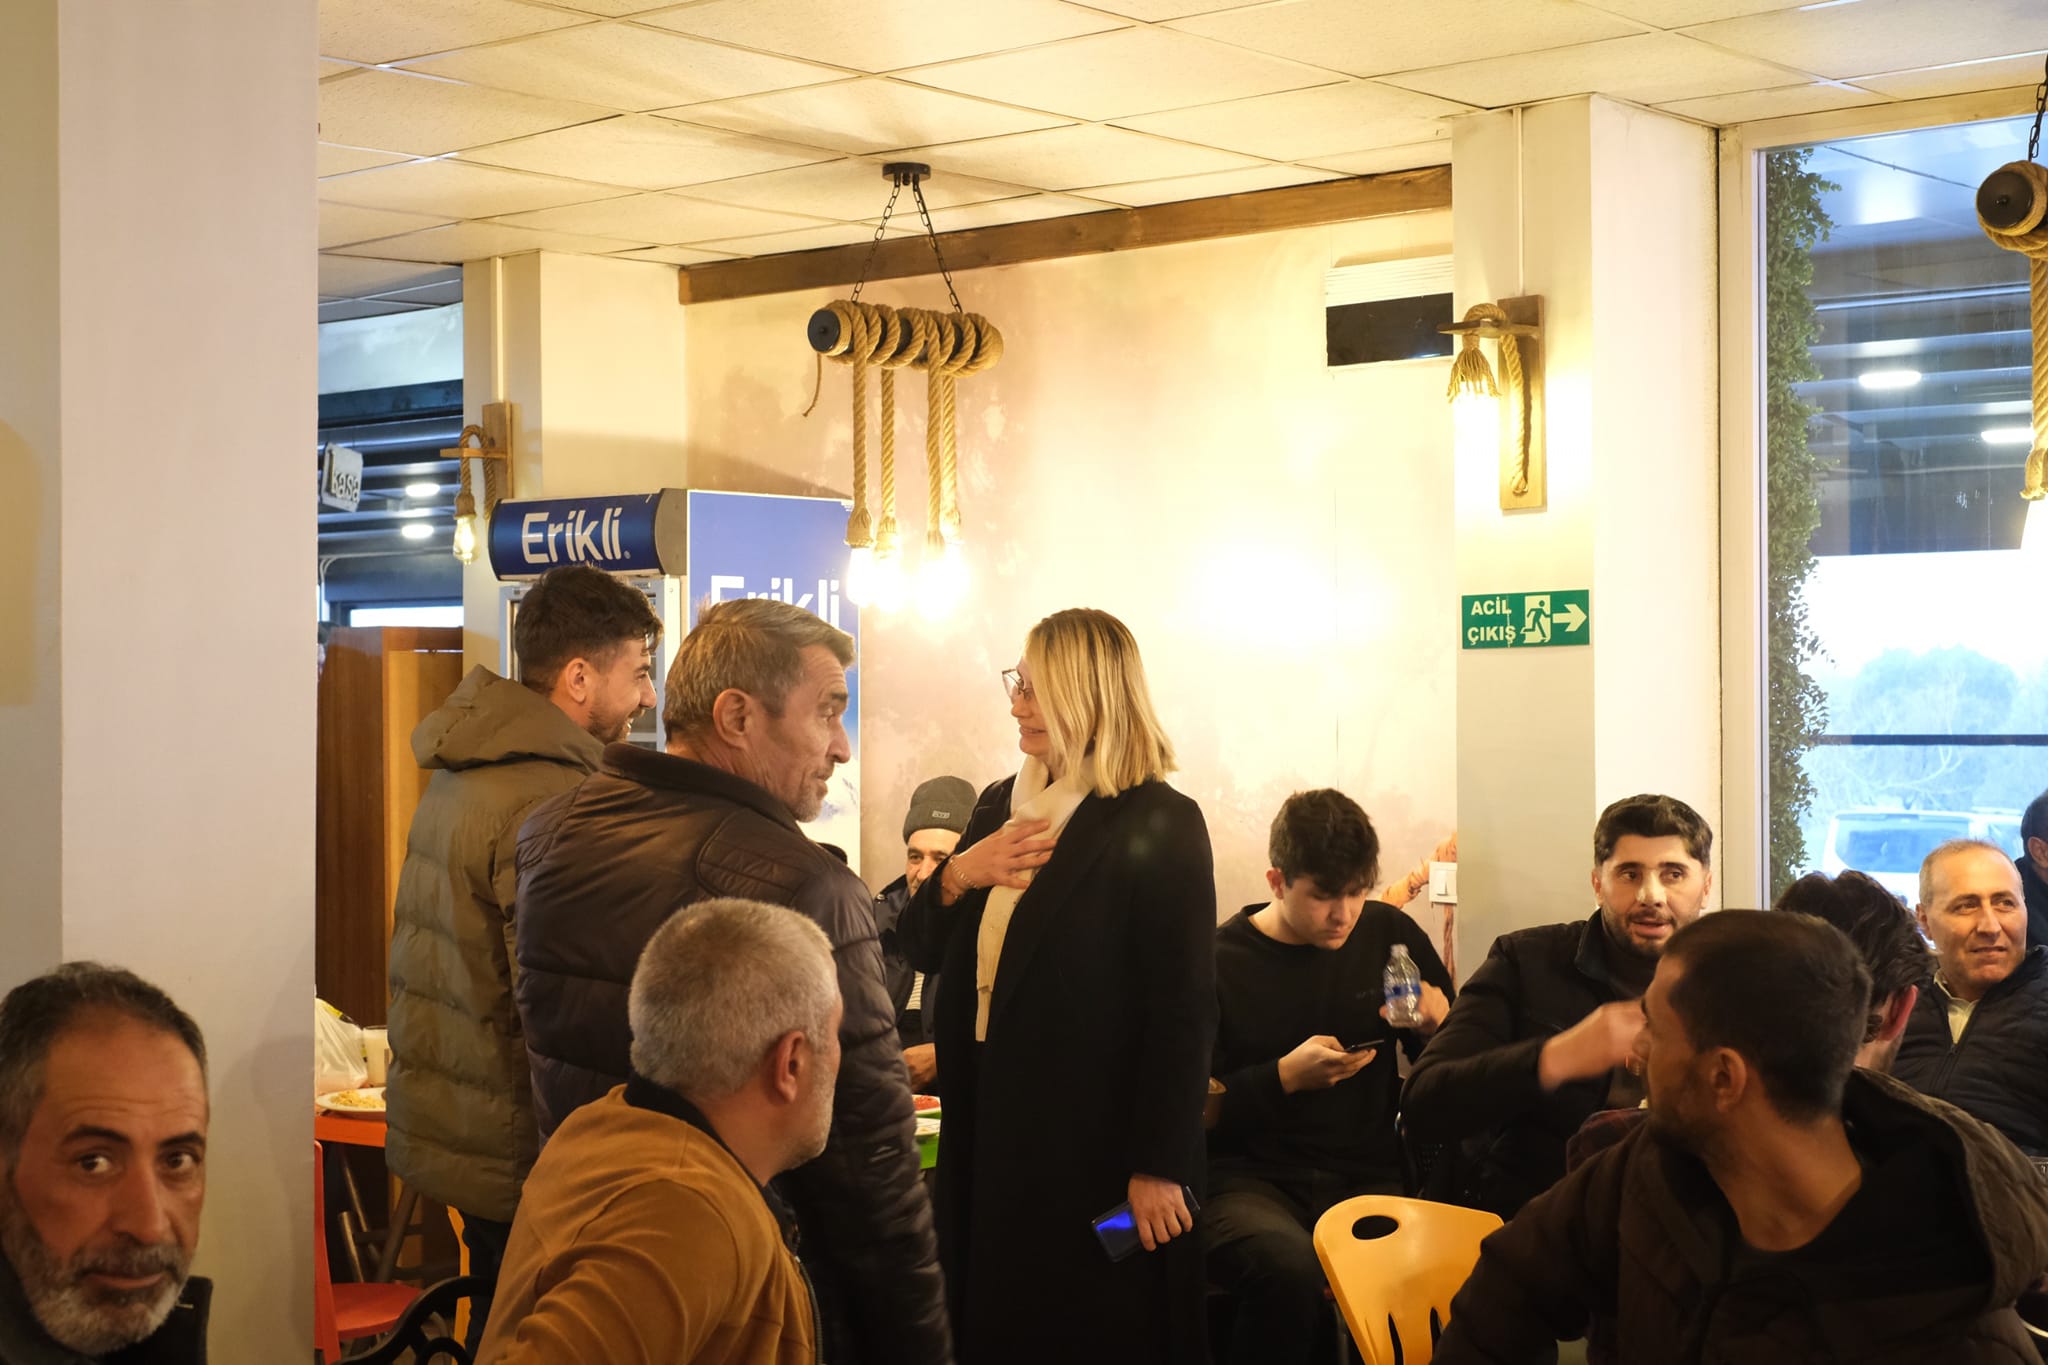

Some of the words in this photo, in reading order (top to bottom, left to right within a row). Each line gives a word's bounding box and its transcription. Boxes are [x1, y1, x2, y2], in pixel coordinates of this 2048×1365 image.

[521, 507, 624, 564] Erikli
[711, 575, 840, 628] Eikli
[1471, 596, 1512, 615] ACİL
[1467, 626, 1516, 645] ÇIKIŞ
